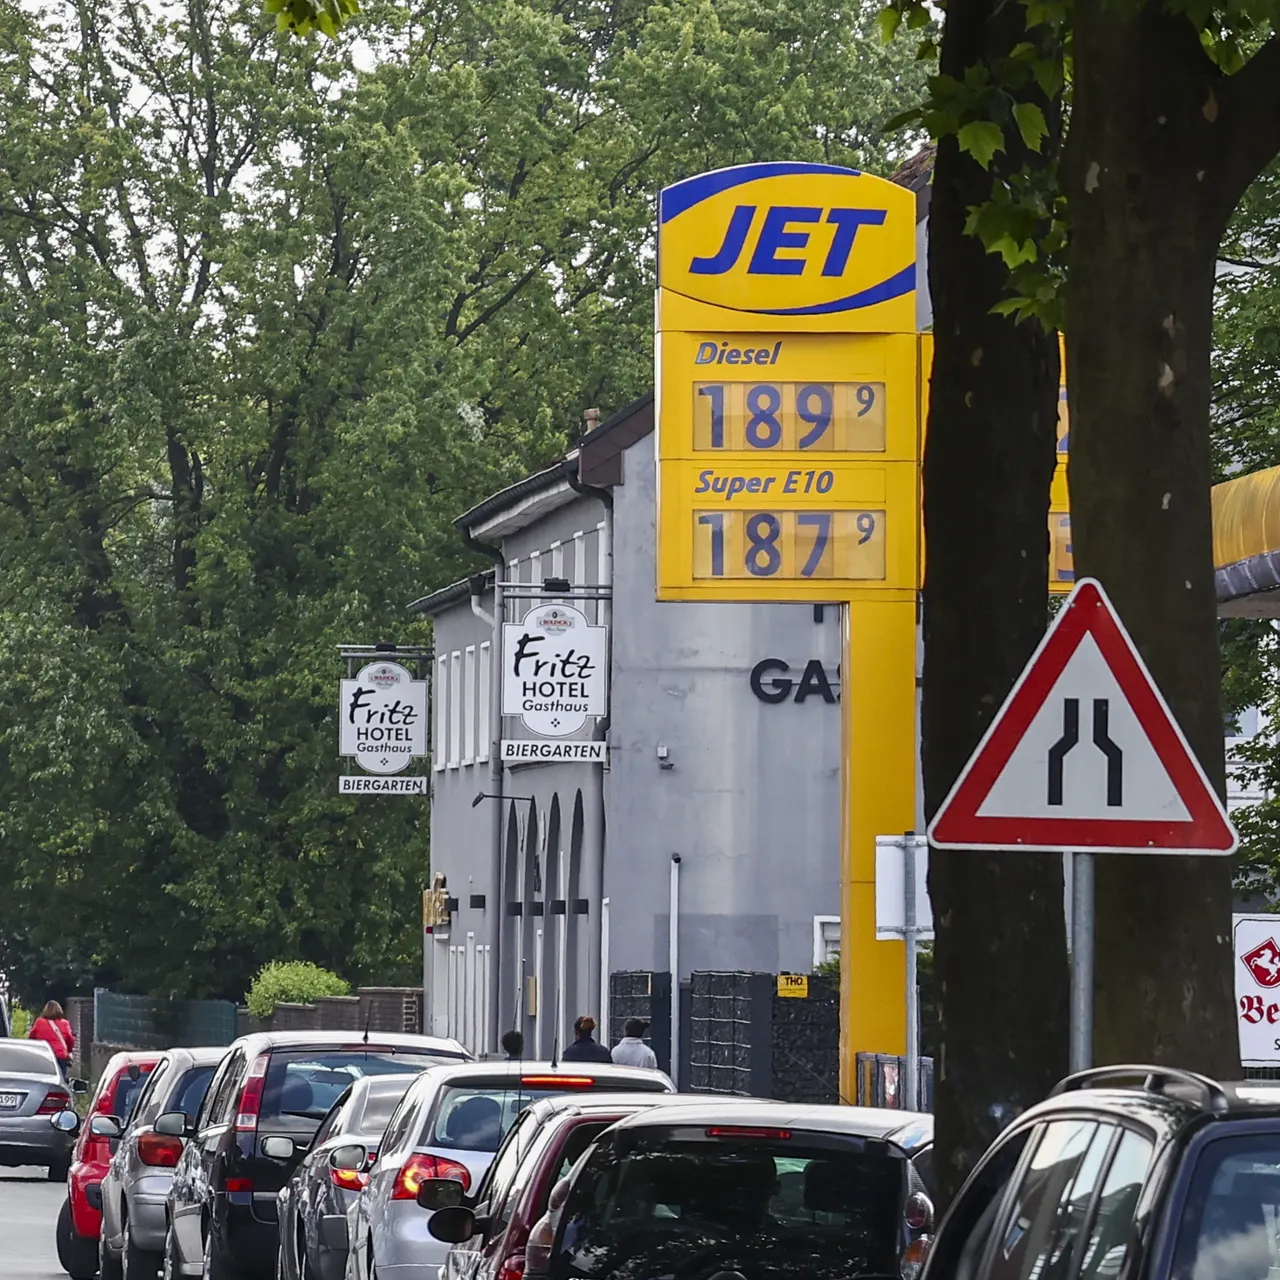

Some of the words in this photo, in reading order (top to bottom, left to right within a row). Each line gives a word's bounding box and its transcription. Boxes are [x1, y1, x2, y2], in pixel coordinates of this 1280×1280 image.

[688, 205, 887, 277] JET
[695, 342, 783, 365] Diesel
[698, 384, 833, 449] 189
[695, 470, 775, 500] Super
[783, 470, 834, 494] E10
[698, 512, 831, 577] 187
[513, 633, 596, 679] Fritz
[522, 681, 590, 698] HOTEL
[750, 658, 840, 703] GA
[349, 687, 418, 725] Fritz
[522, 699, 589, 712] Gasthaus
[357, 727, 413, 741] HOTEL
[356, 742, 412, 753] Gasthaus
[505, 744, 601, 759] BIERGARTEN
[343, 779, 423, 791] BIERGARTEN
